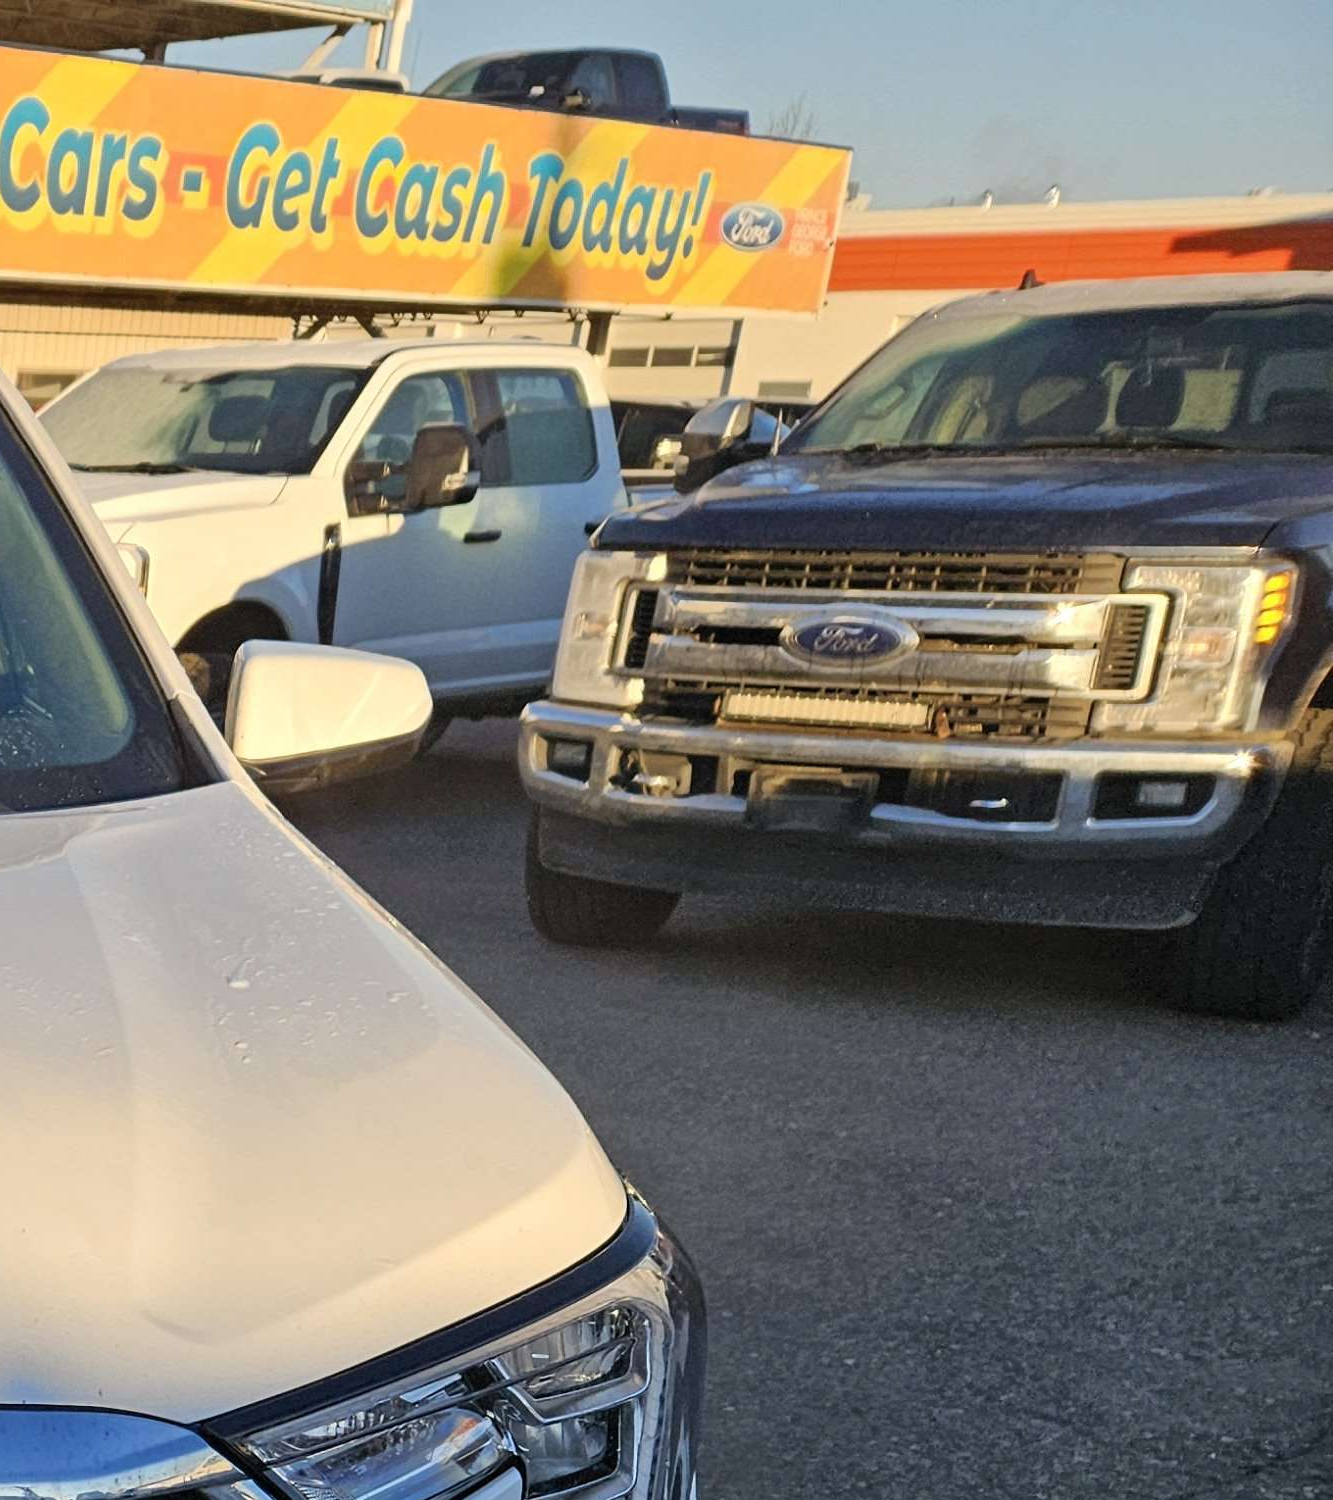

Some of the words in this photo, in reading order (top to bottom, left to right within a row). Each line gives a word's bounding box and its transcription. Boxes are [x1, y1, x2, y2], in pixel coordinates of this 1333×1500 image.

[227, 122, 339, 234] Get
[354, 136, 507, 245] Cash
[521, 151, 712, 282] Today!
[731, 206, 774, 244] Ford
[814, 625, 879, 652] Ford
